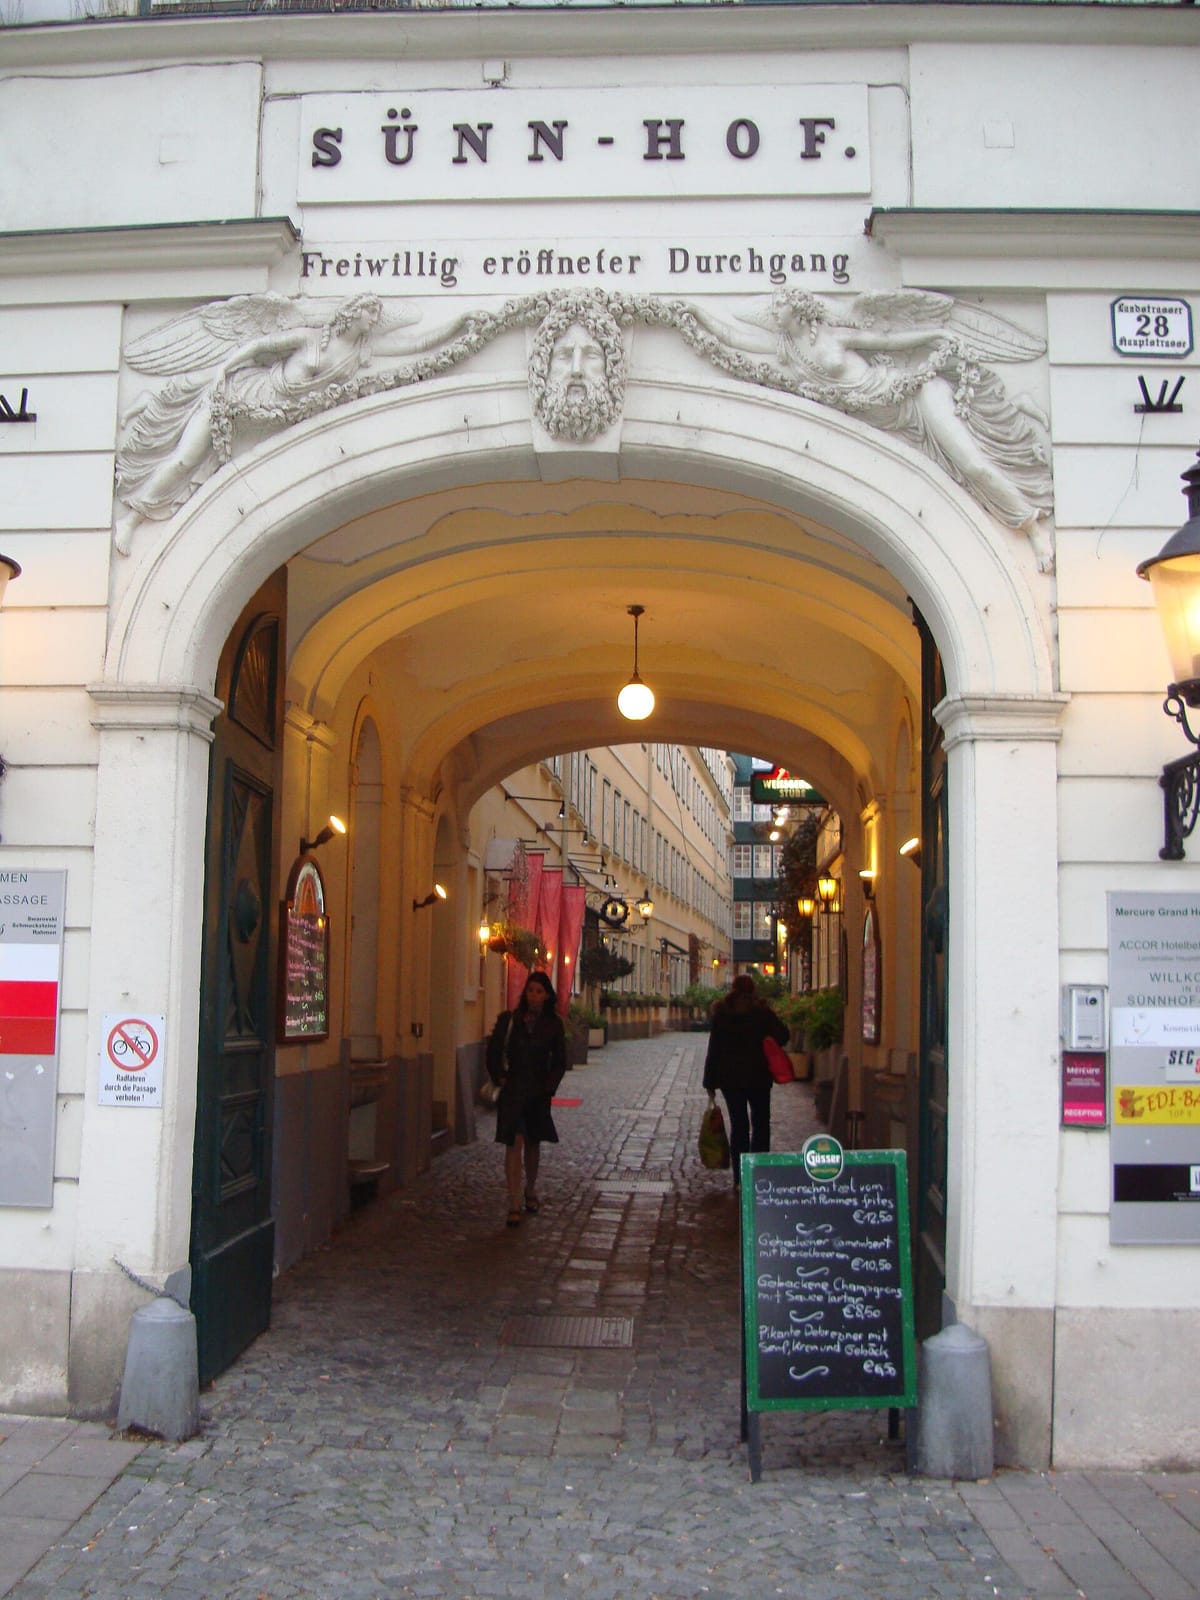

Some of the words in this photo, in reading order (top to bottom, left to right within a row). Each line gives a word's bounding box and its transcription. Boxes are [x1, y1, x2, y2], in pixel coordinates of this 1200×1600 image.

[302, 252, 459, 287] Freiwillig
[483, 249, 641, 276] eröffneter
[669, 247, 850, 285] Durchgang
[1135, 314, 1170, 338] 28
[1115, 907, 1155, 916] Mercure
[1158, 907, 1188, 916] Grand
[1119, 941, 1158, 951] ACCOR
[1066, 1066, 1100, 1075] Mercure
[116, 1073, 146, 1083] Radfahren
[104, 1083, 121, 1092] durch
[122, 1084, 131, 1092] die
[132, 1084, 157, 1094] Passage
[115, 1093, 141, 1102] verboten
[1064, 1108, 1103, 1117] RECEPTION
[859, 1183, 884, 1193] vom
[800, 1196, 817, 1206] mit
[759, 1248, 778, 1258] mit
[758, 1290, 782, 1304] mit
[784, 1290, 825, 1303] Sauce
[758, 1324, 802, 1340] Pikante
[803, 1323, 864, 1343] Debreziner
[867, 1327, 889, 1342] mit
[819, 1342, 842, 1354] und
